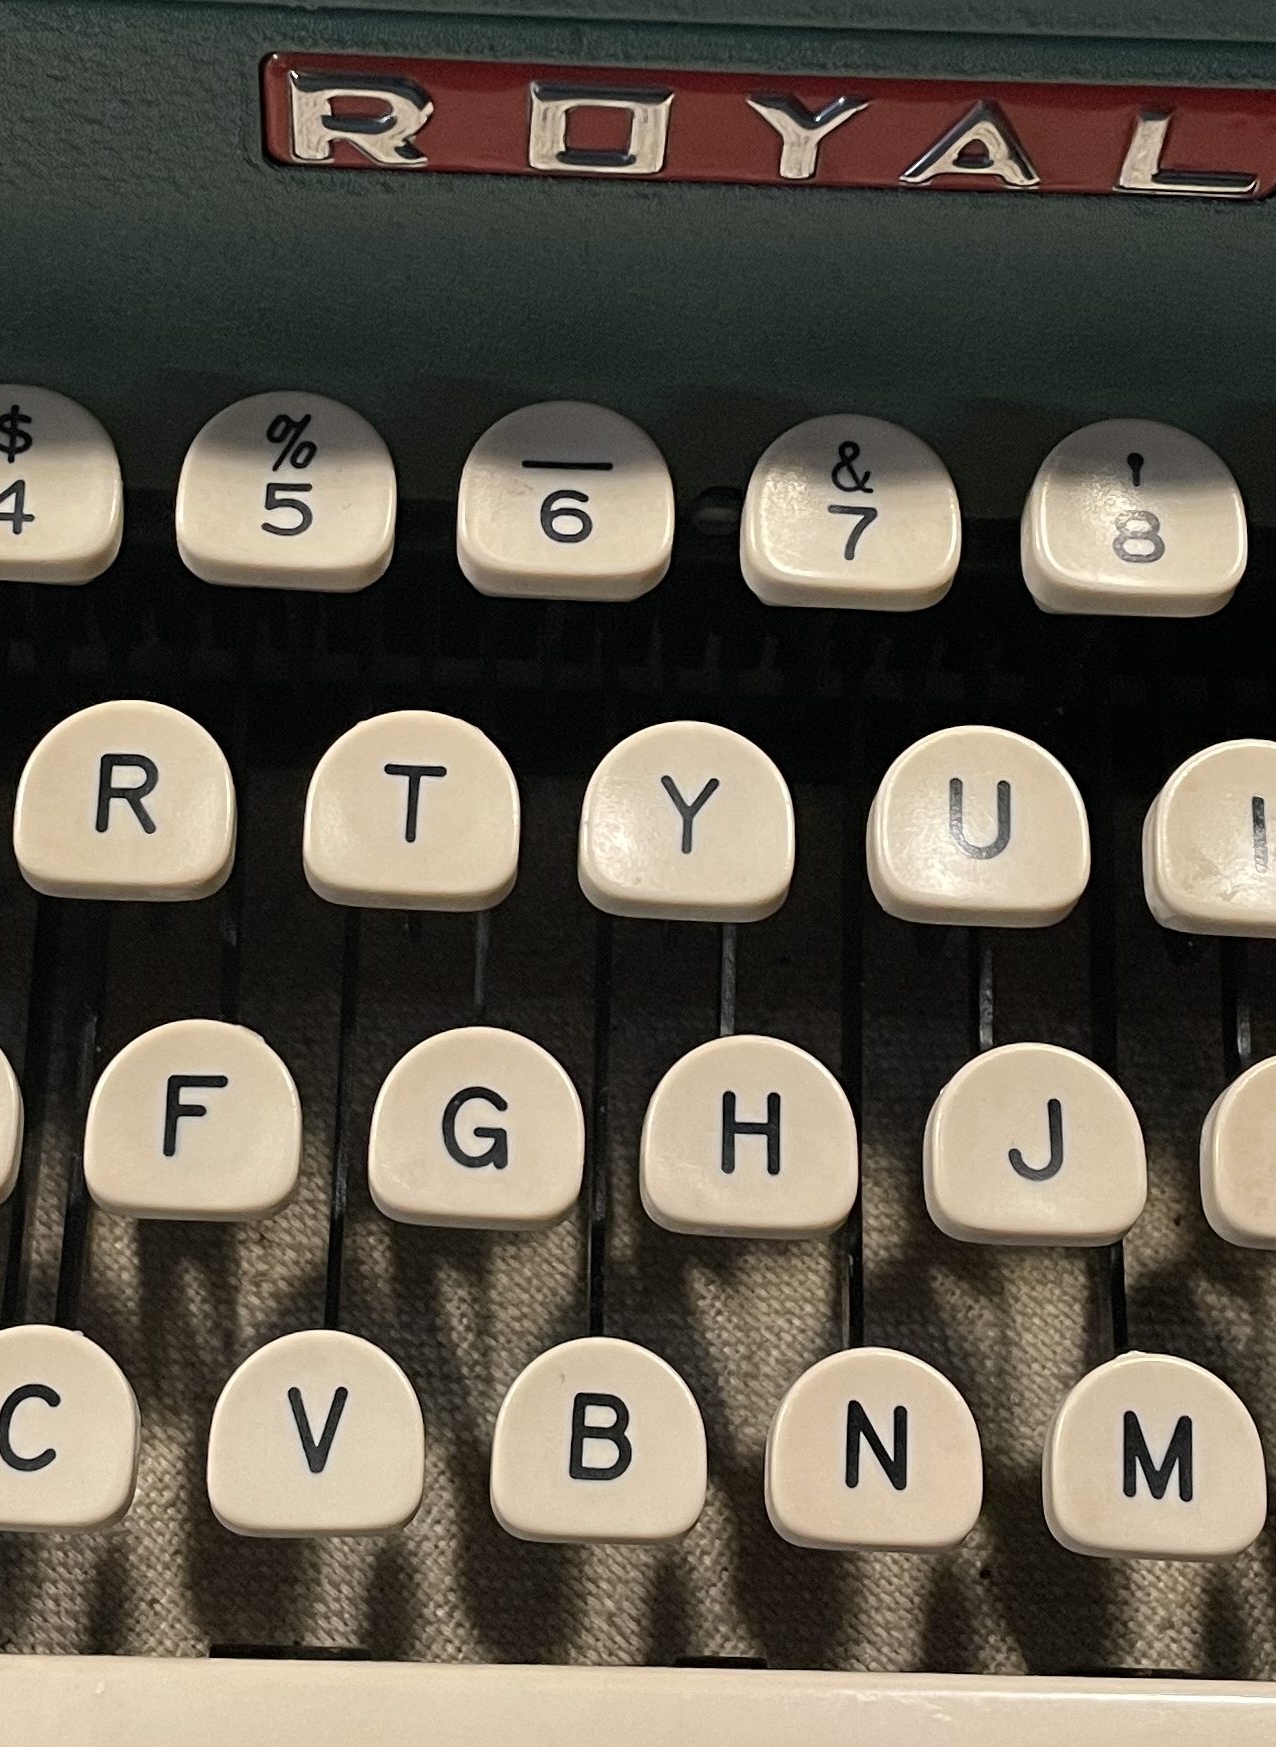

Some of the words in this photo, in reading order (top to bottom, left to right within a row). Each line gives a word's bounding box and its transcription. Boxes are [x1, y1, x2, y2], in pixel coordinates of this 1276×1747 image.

[289, 70, 1259, 194] ROYAL
[266, 413, 318, 472] %
[831, 441, 874, 494] &
[261, 483, 313, 536] 5
[540, 489, 593, 543] 6
[828, 505, 878, 560] 7
[1113, 510, 1165, 563] 8
[95, 753, 159, 834] R
[384, 764, 447, 843] T
[661, 775, 720, 854] Y
[949, 778, 1011, 859] U
[1251, 794, 1268, 875] I
[163, 1075, 228, 1157] F
[442, 1086, 508, 1170] G
[721, 1090, 781, 1176] H
[1008, 1098, 1063, 1181] J
[288, 1387, 348, 1474] V
[569, 1392, 632, 1481] B
[845, 1400, 908, 1491] N
[1123, 1410, 1193, 1502] M
